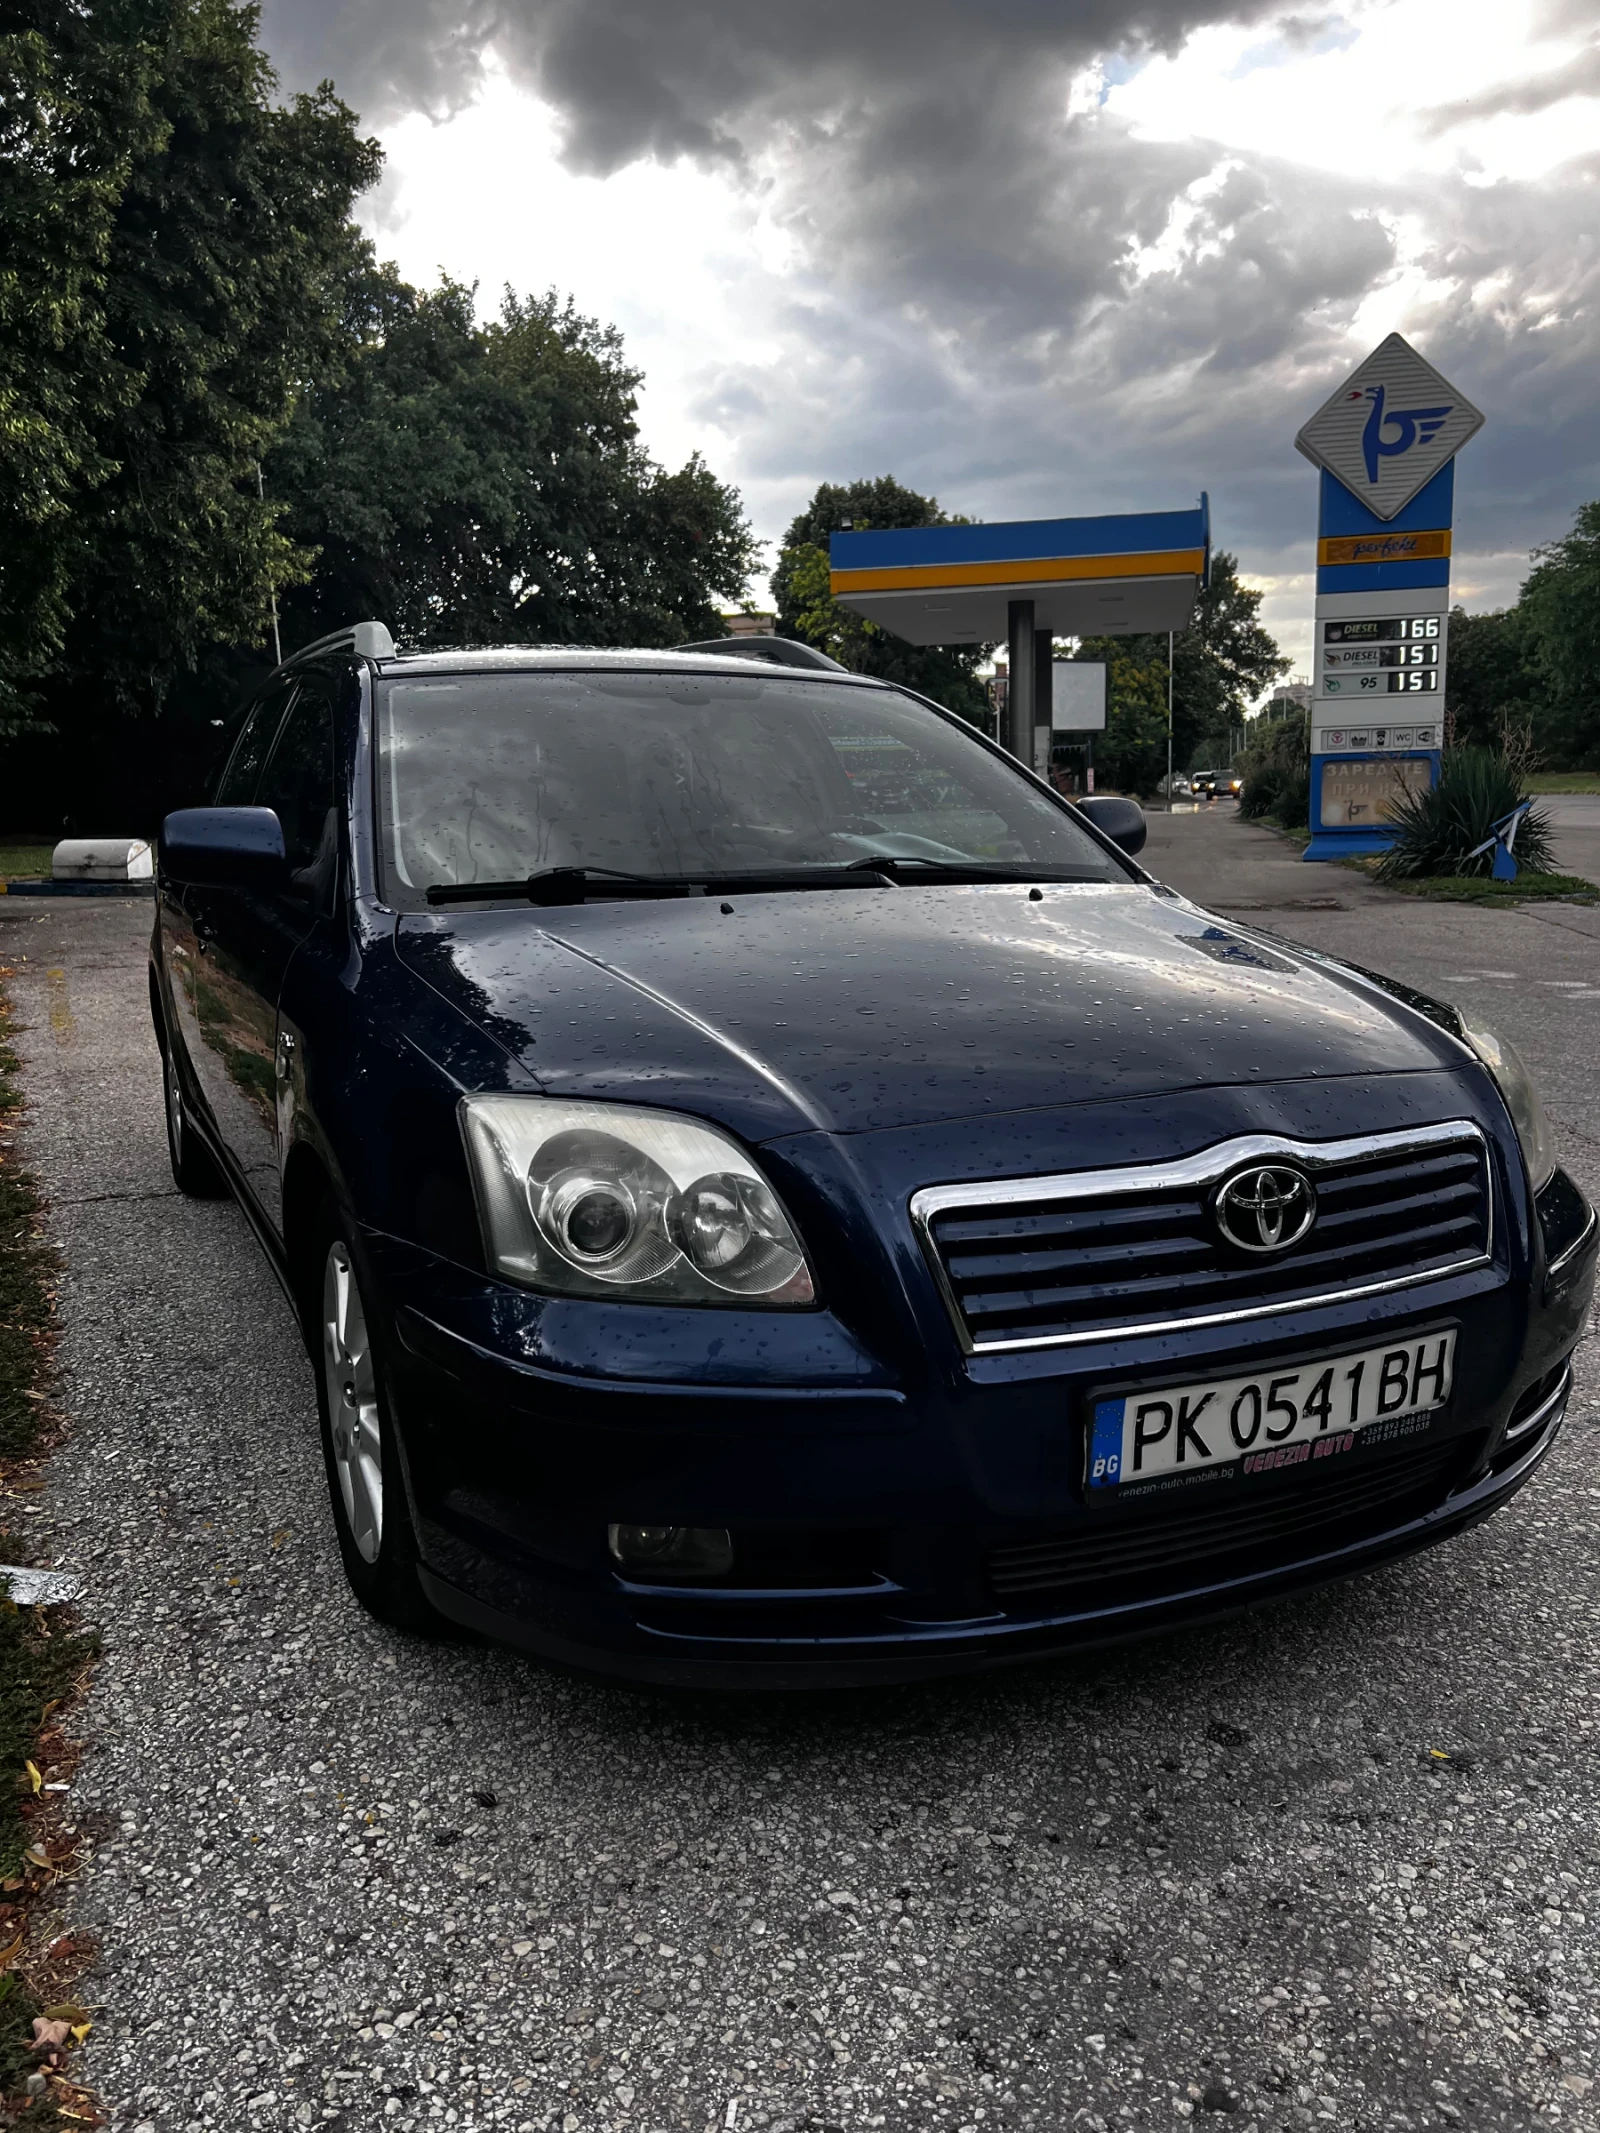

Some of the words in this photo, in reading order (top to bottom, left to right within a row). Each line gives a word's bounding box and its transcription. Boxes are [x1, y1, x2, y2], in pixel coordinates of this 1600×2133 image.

[1344, 623, 1378, 634] DIESEL
[1401, 619, 1439, 638] 166
[1343, 651, 1378, 662] DIESEL
[1400, 645, 1437, 665] 151
[1360, 677, 1378, 689] 95
[1398, 671, 1436, 691] 151
[1396, 733, 1411, 741] WC
[1332, 783, 1371, 796] ПРИ
[1133, 1392, 1217, 1471] PK
[1230, 1361, 1365, 1449] 0541
[1377, 1339, 1448, 1415] BH
[1361, 1434, 1381, 1445] +359
[1243, 1440, 1310, 1474] VENEZIA
[1313, 1432, 1355, 1459] AUTO
[1092, 1454, 1119, 1478] BG
[1118, 1467, 1235, 1498] venezia-auto.mobile.bg
